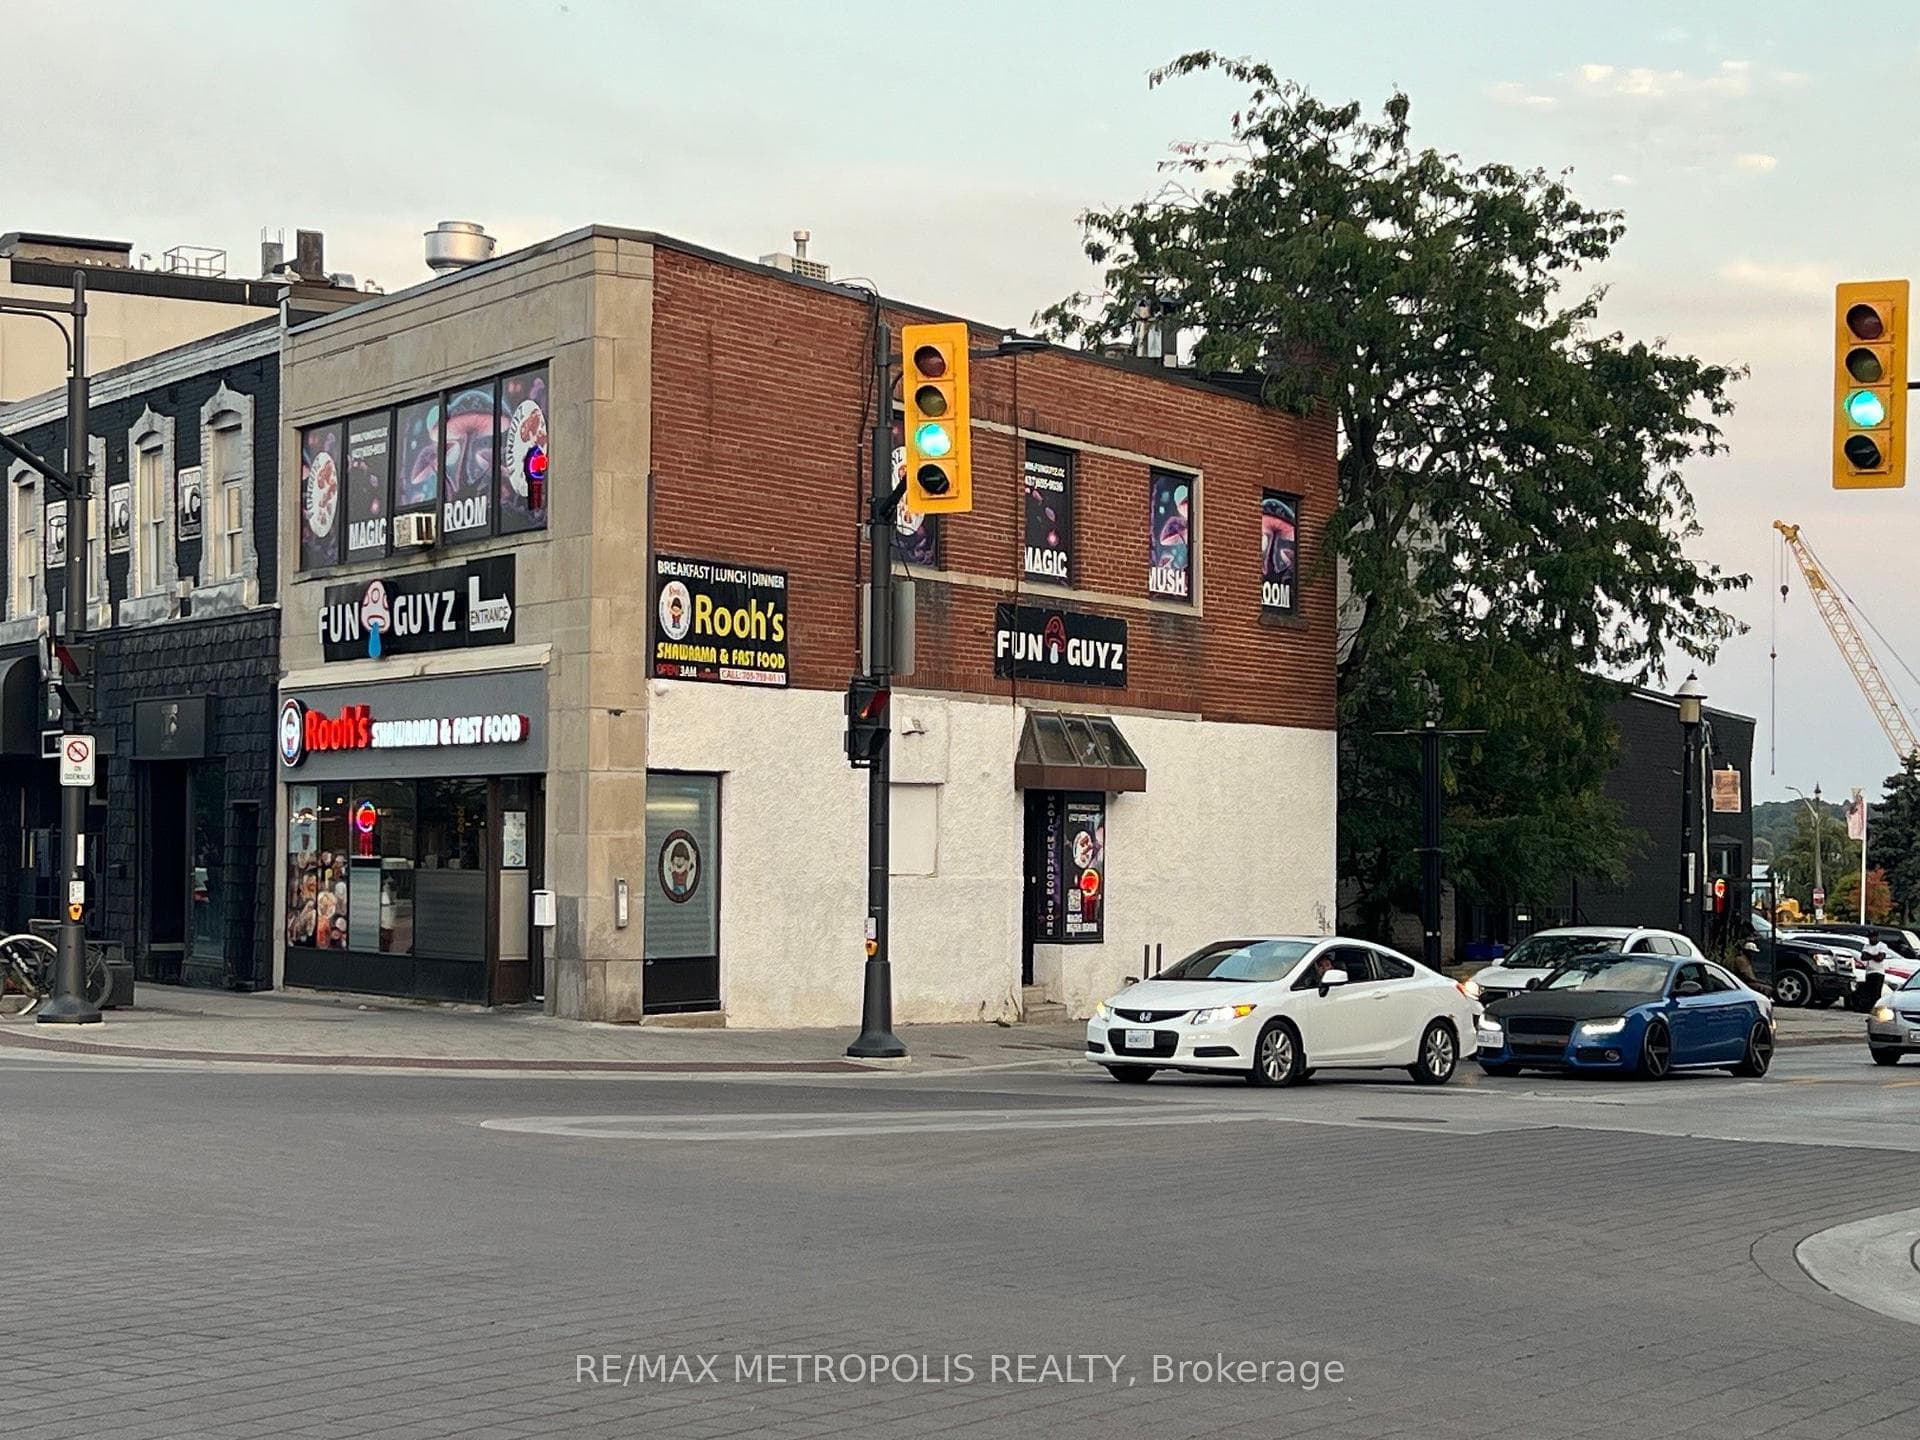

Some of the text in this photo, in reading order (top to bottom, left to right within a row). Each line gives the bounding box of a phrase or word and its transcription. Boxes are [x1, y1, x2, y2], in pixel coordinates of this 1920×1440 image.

[443, 495, 487, 532] ROOM
[349, 517, 387, 550] MAGIC
[657, 560, 785, 589] BREAKFAST LUNCH DINNER
[1262, 581, 1291, 608] OOM
[319, 590, 457, 644] FUN GUYZ
[470, 605, 509, 626] ENTRANCE
[695, 594, 784, 642] Rooh's
[656, 642, 785, 669] SHAWARMA & FAST FOOD
[997, 630, 1123, 670] FUN GUYZ
[305, 705, 370, 751] Rooh's
[440, 718, 451, 746] &
[452, 716, 482, 745] FAST
[484, 714, 521, 743] FOOD
